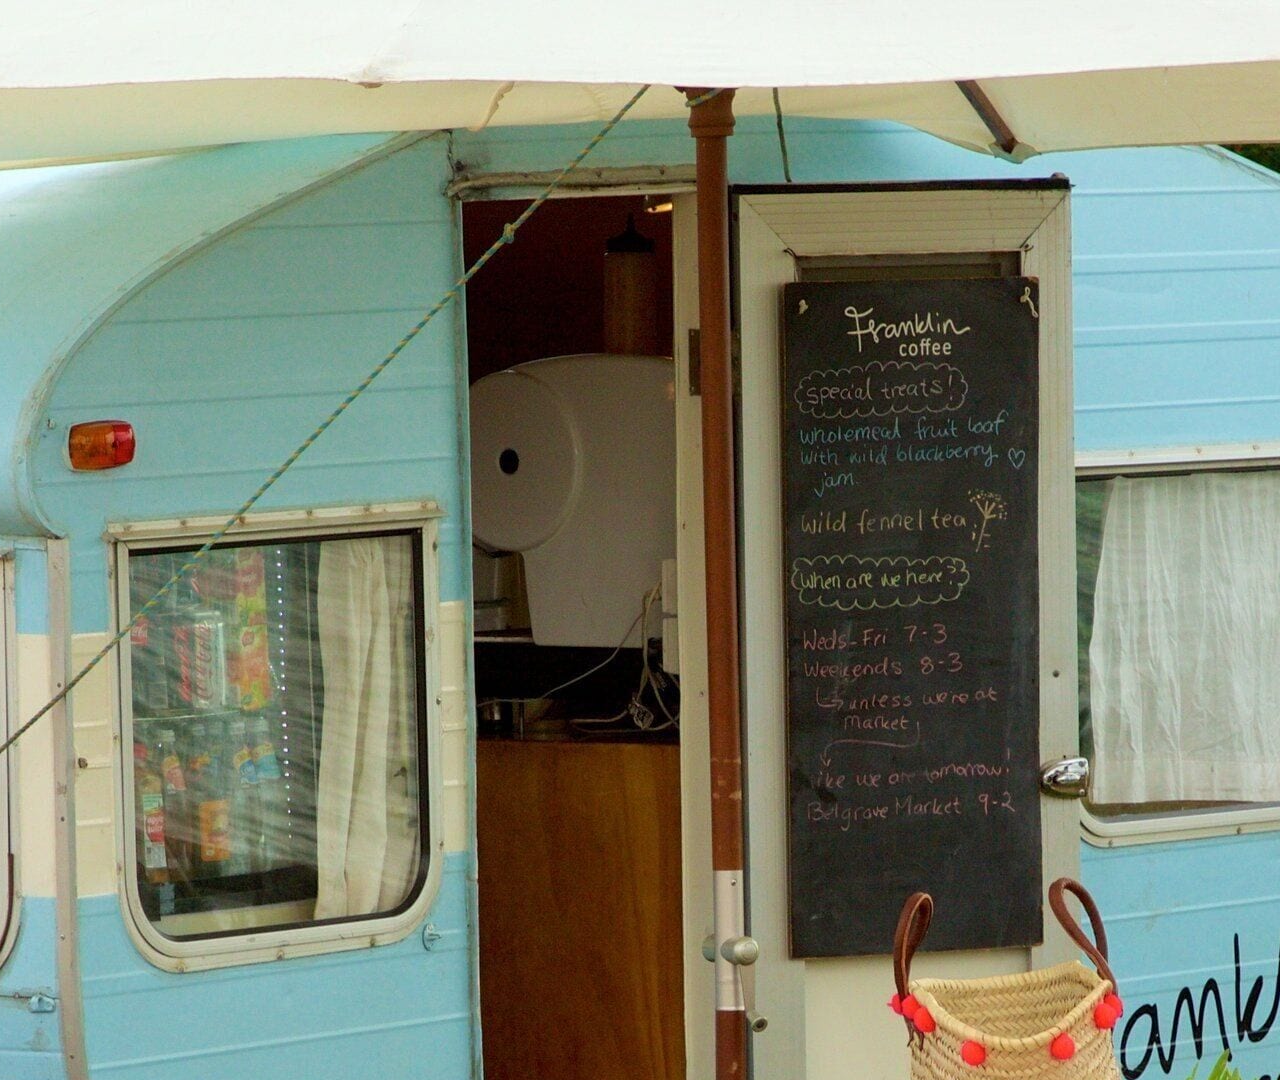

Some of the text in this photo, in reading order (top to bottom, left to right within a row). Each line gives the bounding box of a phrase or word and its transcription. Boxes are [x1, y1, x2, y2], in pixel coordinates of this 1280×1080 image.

[844, 306, 970, 352] Franklin
[899, 340, 953, 357] coffee
[806, 374, 955, 405] special treats!
[800, 409, 1009, 446] wholemeal fruit loaf
[849, 443, 888, 466] wild
[896, 443, 999, 468] blackberry
[801, 511, 847, 535] wild
[857, 508, 923, 535] fennel
[845, 571, 873, 590] are
[881, 572, 901, 588] we
[804, 656, 903, 679] Weekends
[849, 692, 913, 711] unless
[974, 686, 998, 703] at
[856, 773, 881, 788] we
[807, 801, 889, 832] Belgrave
[895, 794, 962, 816] Market
